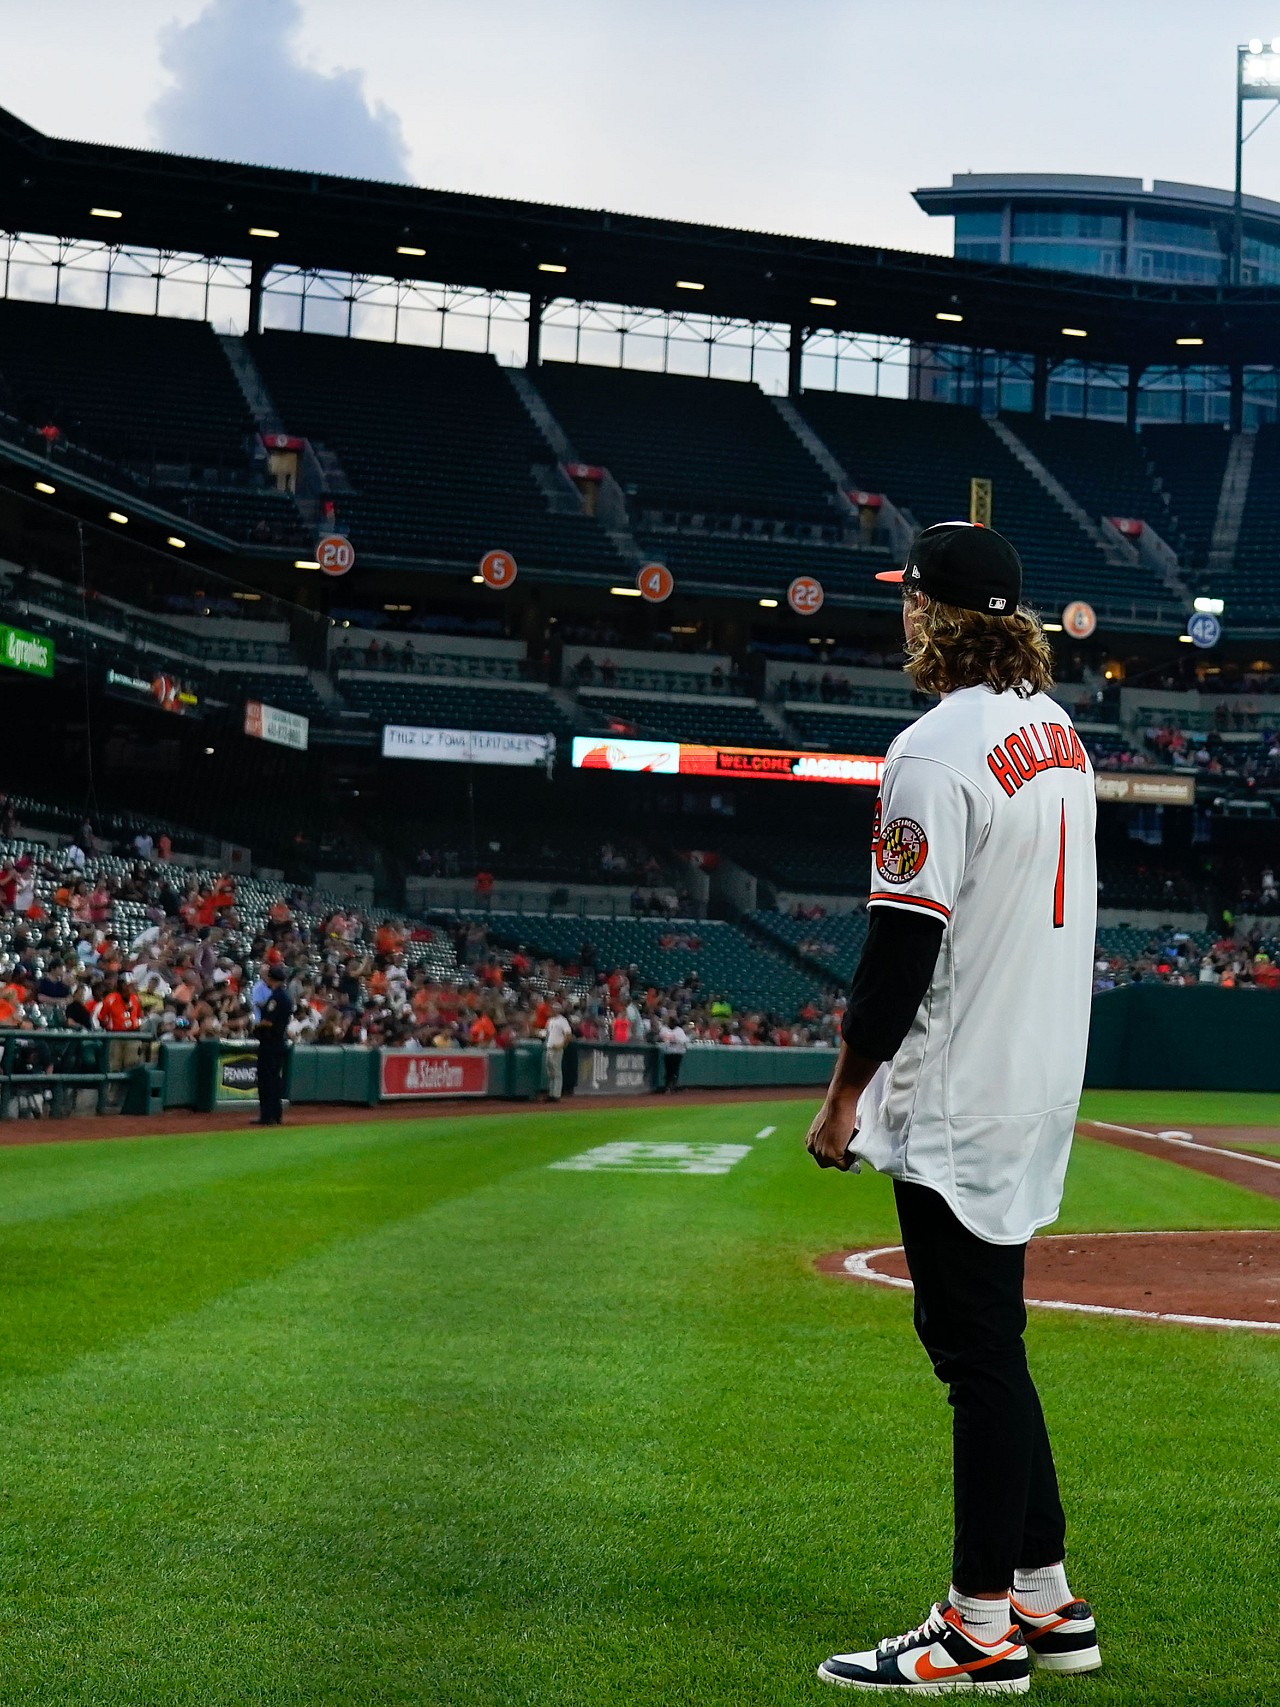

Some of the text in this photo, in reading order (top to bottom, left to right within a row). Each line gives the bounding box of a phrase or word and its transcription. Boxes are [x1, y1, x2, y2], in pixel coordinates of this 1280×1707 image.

[324, 544, 349, 567] 20
[492, 558, 506, 580] 5
[647, 572, 662, 593] 4
[793, 584, 819, 607] 22
[718, 753, 877, 780] WELCOME JACKSON
[987, 722, 1087, 799] HOLLIDA
[881, 819, 926, 843] BALTIMORE
[879, 866, 917, 882] ORIOLES
[1053, 797, 1066, 929] 1
